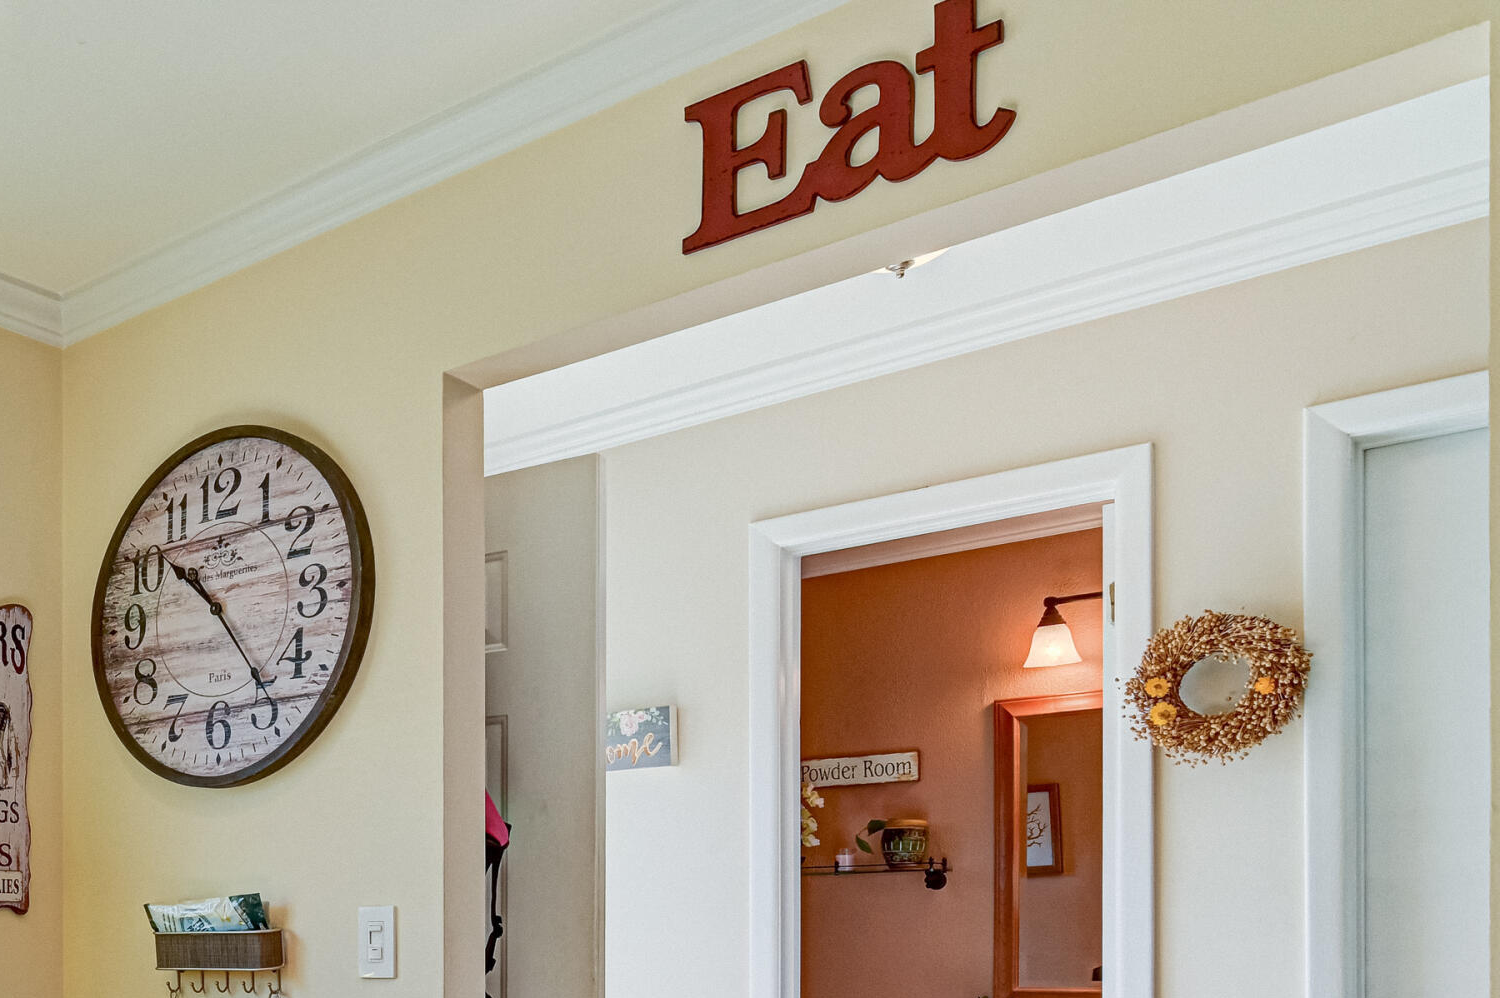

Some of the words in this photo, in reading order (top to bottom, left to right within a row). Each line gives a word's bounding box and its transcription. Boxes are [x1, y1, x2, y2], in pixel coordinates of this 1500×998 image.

[682, 0, 1017, 255] Eat
[164, 492, 188, 545] 11
[199, 466, 242, 524] 12
[257, 472, 272, 524] 1
[284, 505, 316, 560] 2
[129, 544, 164, 597] 10
[297, 563, 328, 619] 3
[123, 603, 147, 650] 9
[208, 670, 232, 684] Paris
[276, 627, 313, 680] 4
[133, 658, 159, 706] 8
[250, 675, 279, 730] 5
[166, 694, 189, 743] 7
[205, 700, 232, 750] 6
[606, 733, 663, 766] ome
[801, 762, 857, 783] Powder
[864, 759, 912, 778] Room
